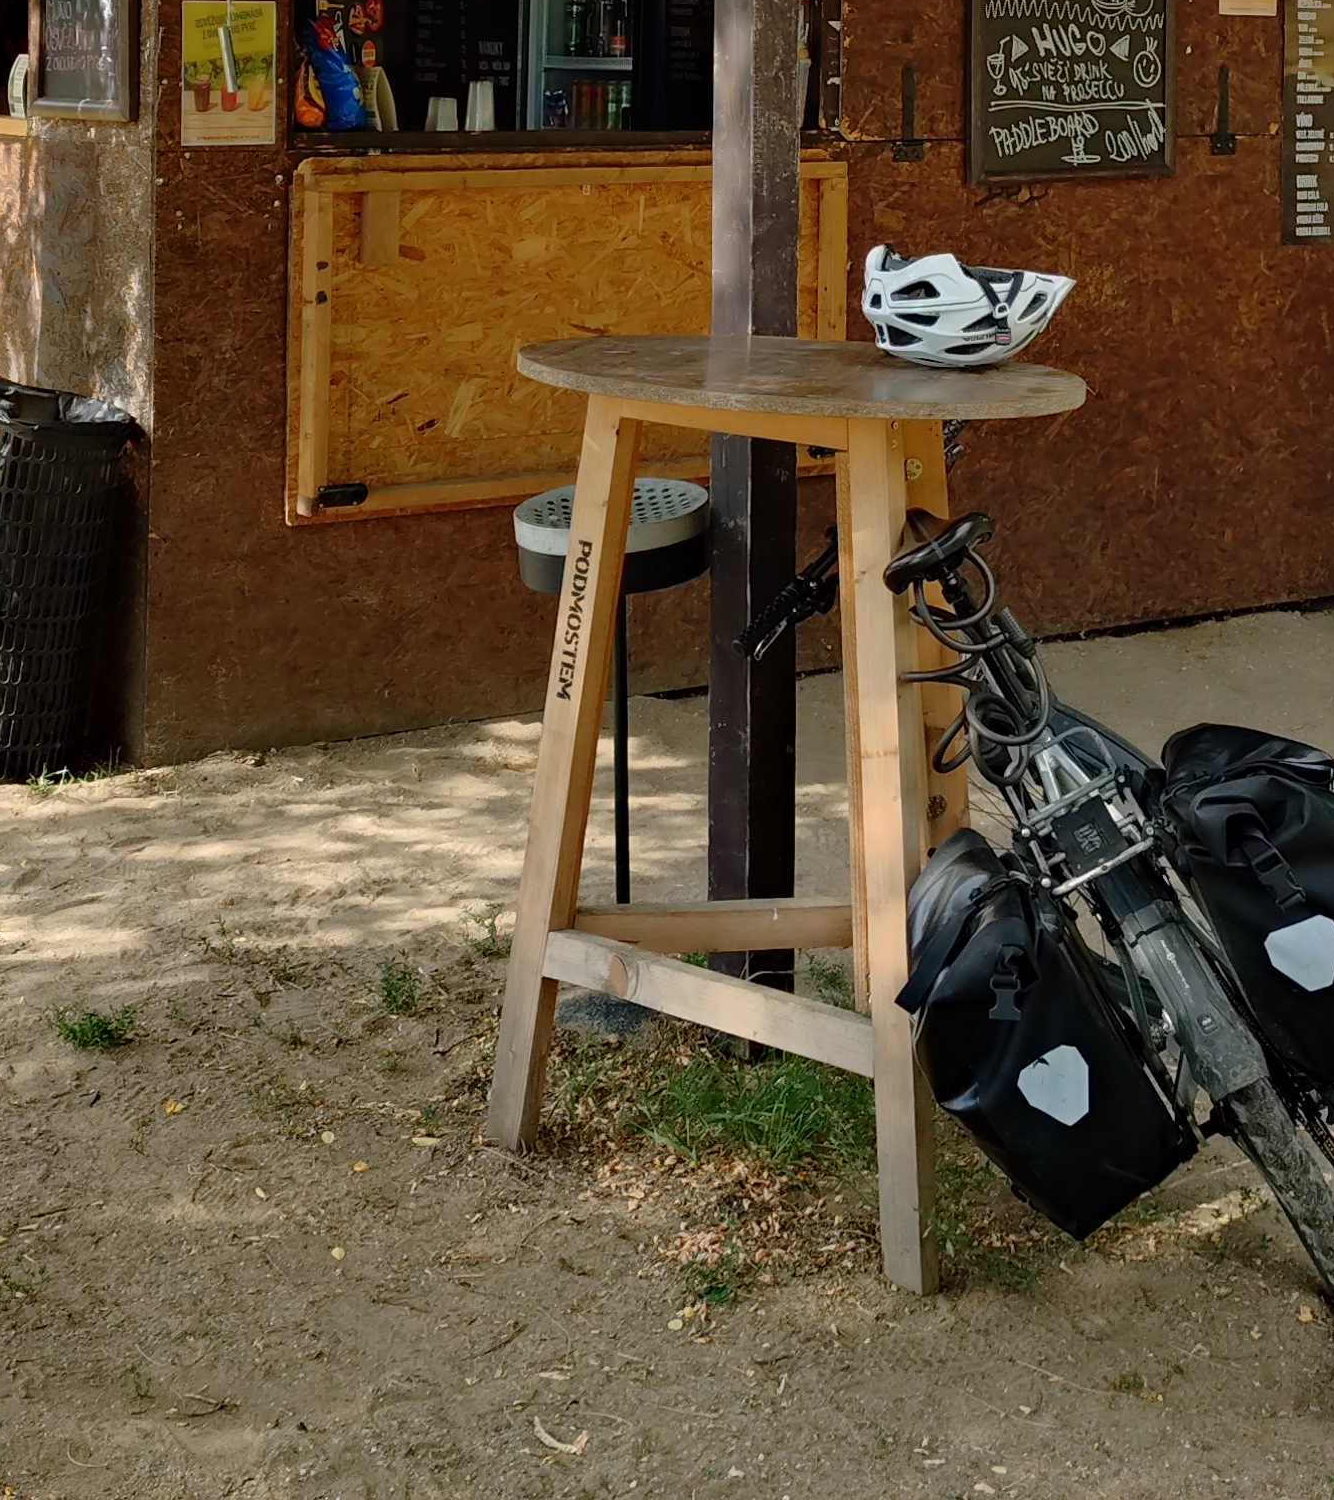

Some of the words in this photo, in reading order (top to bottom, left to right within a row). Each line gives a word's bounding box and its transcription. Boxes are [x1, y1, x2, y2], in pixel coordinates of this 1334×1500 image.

[1031, 23, 1106, 57] HUGO
[1073, 62, 1113, 81] DRINK
[1041, 85, 1057, 101] NA
[989, 111, 1099, 157] PADDLEBOARD
[556, 539, 593, 701] PODMOSTEM
